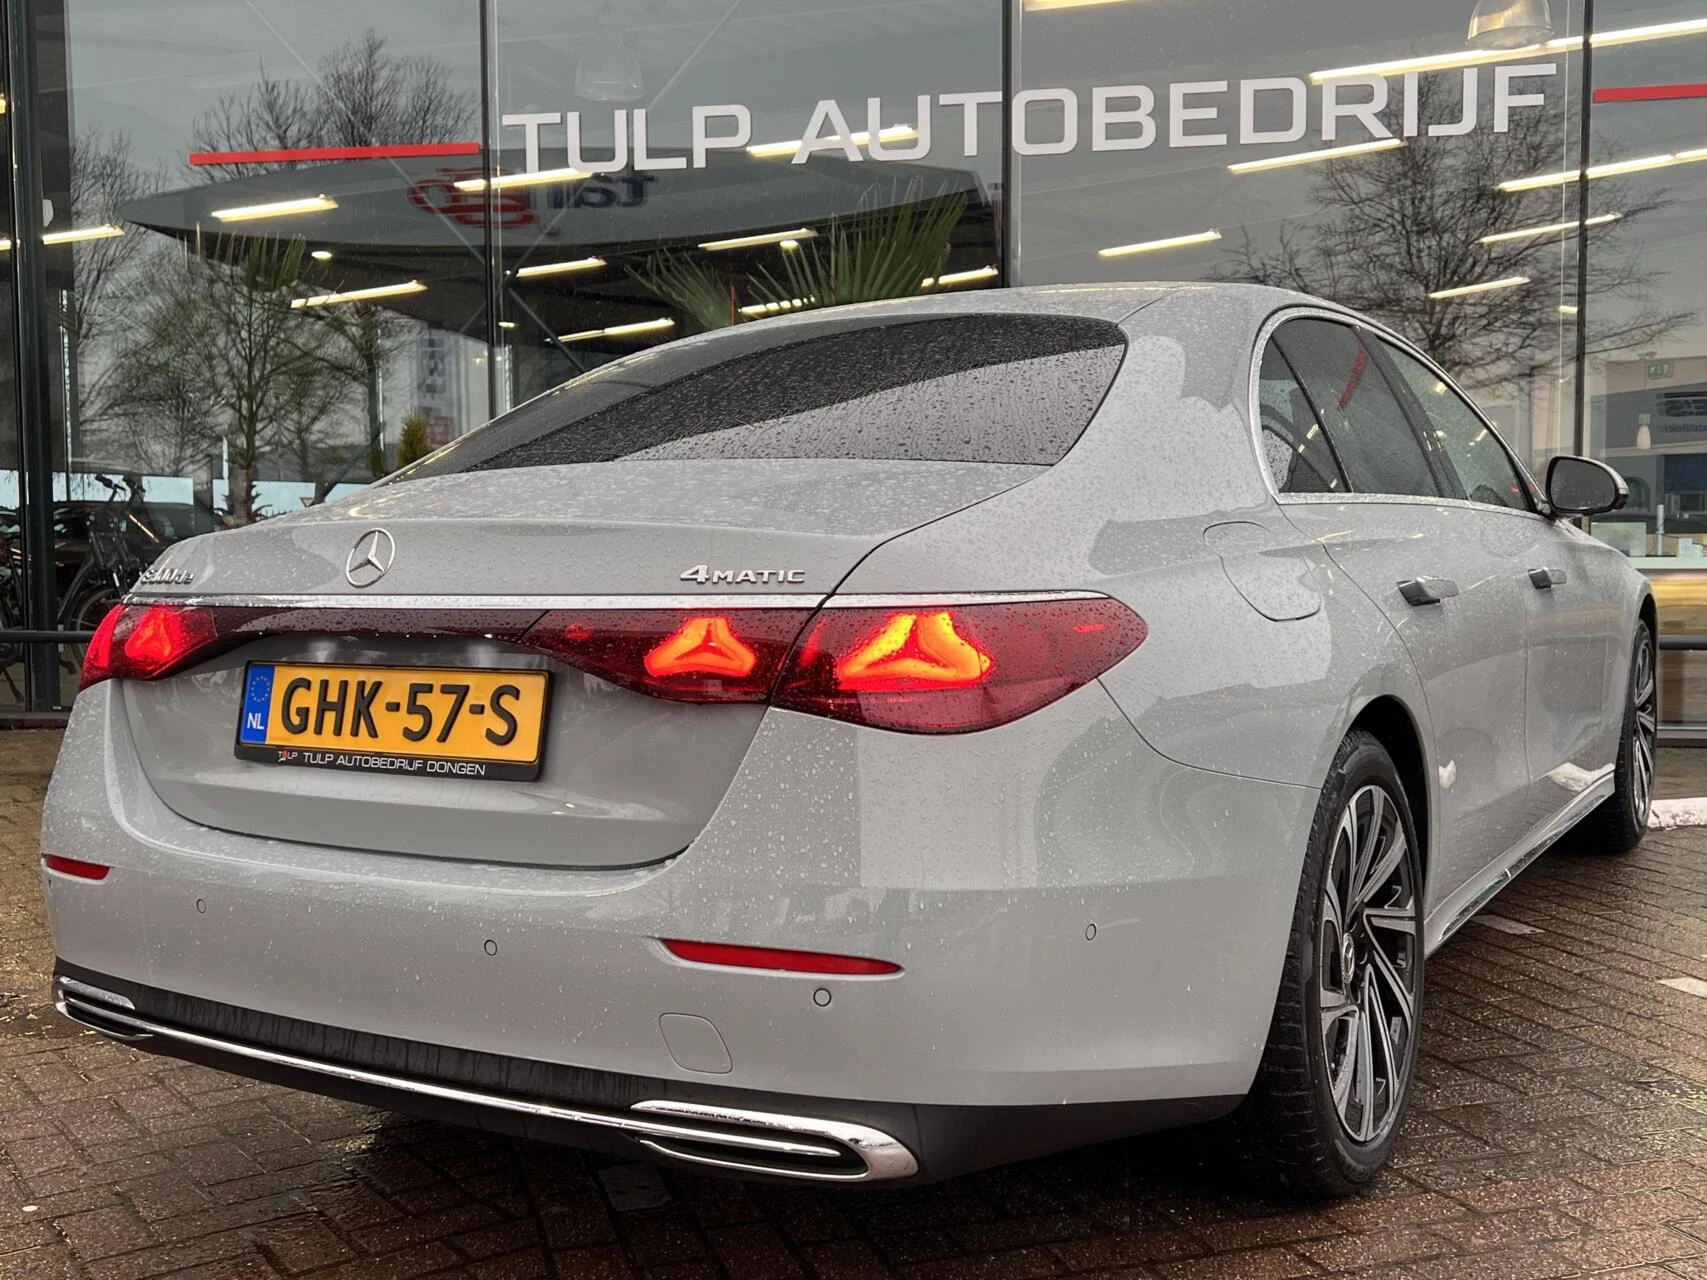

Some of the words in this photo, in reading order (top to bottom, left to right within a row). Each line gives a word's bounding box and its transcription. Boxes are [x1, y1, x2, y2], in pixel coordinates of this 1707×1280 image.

[501, 104, 753, 174] TULP
[791, 62, 1557, 165] AUTOBEDRIJF
[680, 564, 806, 584] 4MATIC
[247, 713, 265, 730] NL
[281, 677, 521, 746] GHK-57-S
[303, 752, 334, 765] TULP
[336, 755, 423, 771] AUTOBEDRIJF
[427, 760, 486, 776] DONGEN
